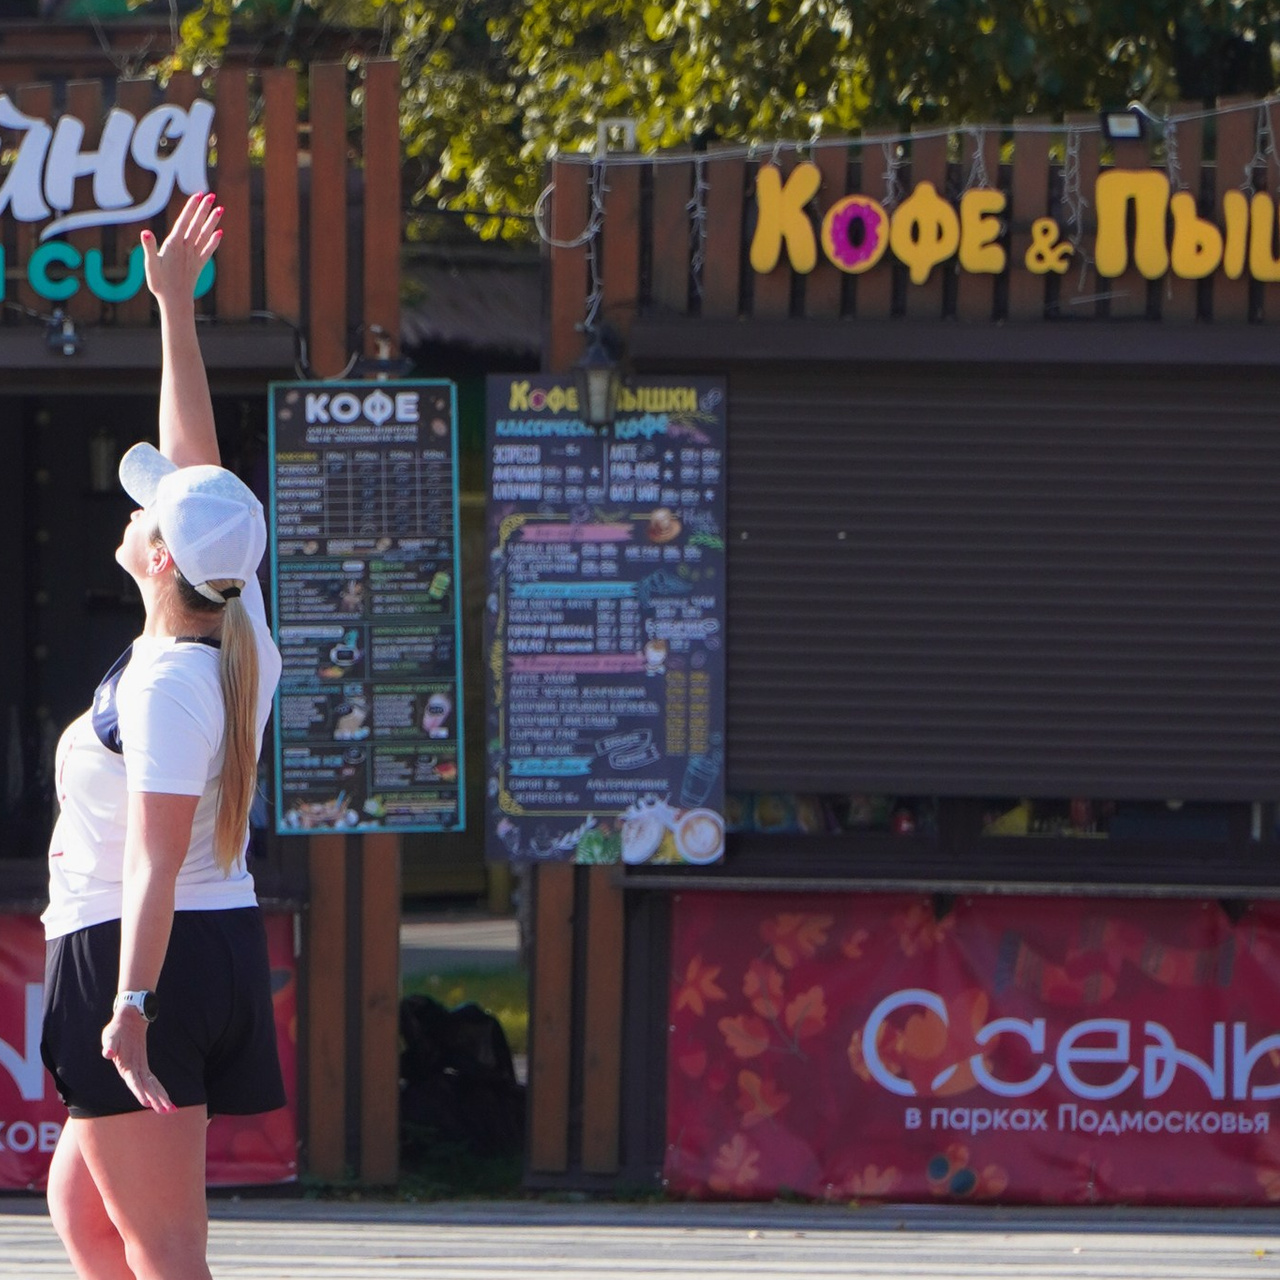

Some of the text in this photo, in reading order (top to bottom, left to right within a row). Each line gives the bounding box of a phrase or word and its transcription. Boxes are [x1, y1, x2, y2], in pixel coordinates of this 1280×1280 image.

[749, 162, 1007, 286] КОФЕ
[1024, 217, 1074, 275] &
[26, 240, 217, 303] CU
[304, 389, 420, 427] КОФЕ
[509, 379, 698, 414] КОФЕ ЫШКИ
[906, 1104, 1269, 1136] в парках Подмосковья
